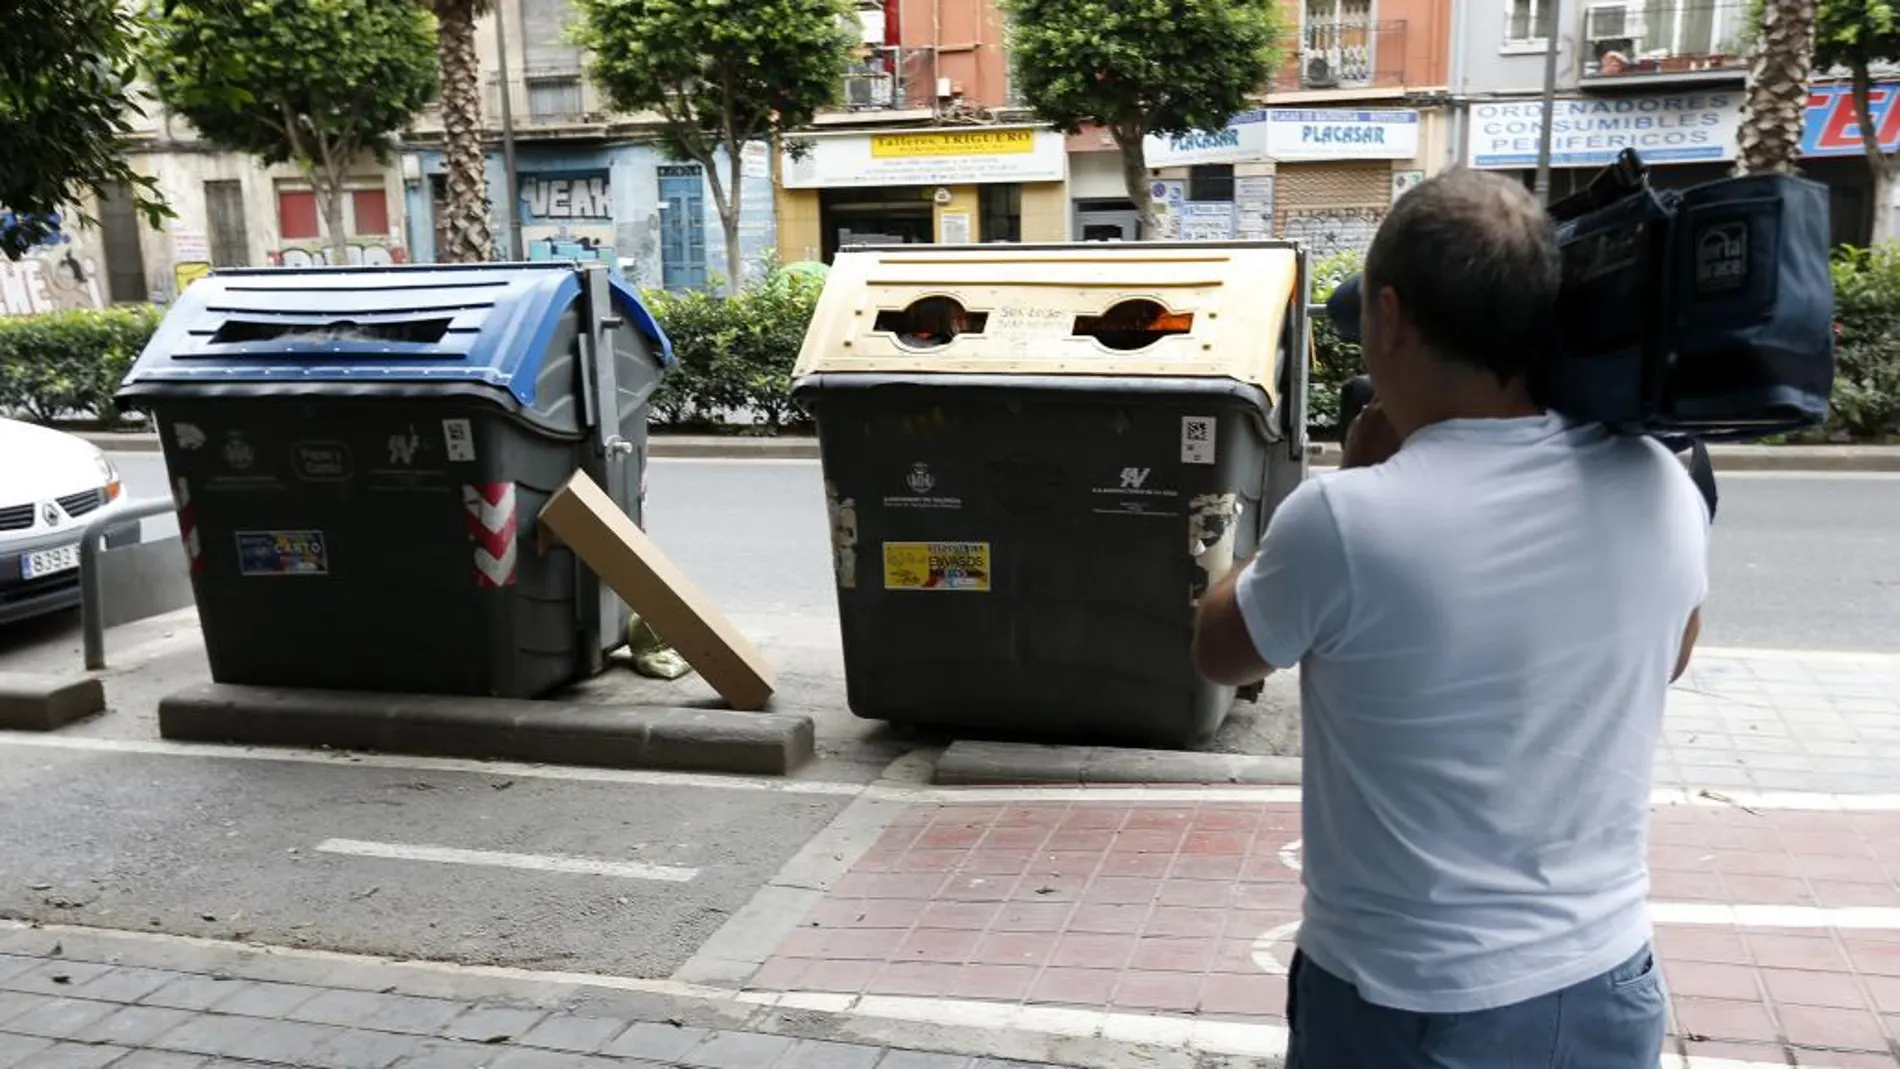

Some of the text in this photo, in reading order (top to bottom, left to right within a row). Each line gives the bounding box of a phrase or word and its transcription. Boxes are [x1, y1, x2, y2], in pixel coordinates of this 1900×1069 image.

[1477, 95, 1729, 119] ORDENADORES
[1302, 125, 1385, 145] PLACASAR
[1483, 113, 1720, 135] CONSUMIBLES
[32, 547, 72, 573] 8393
